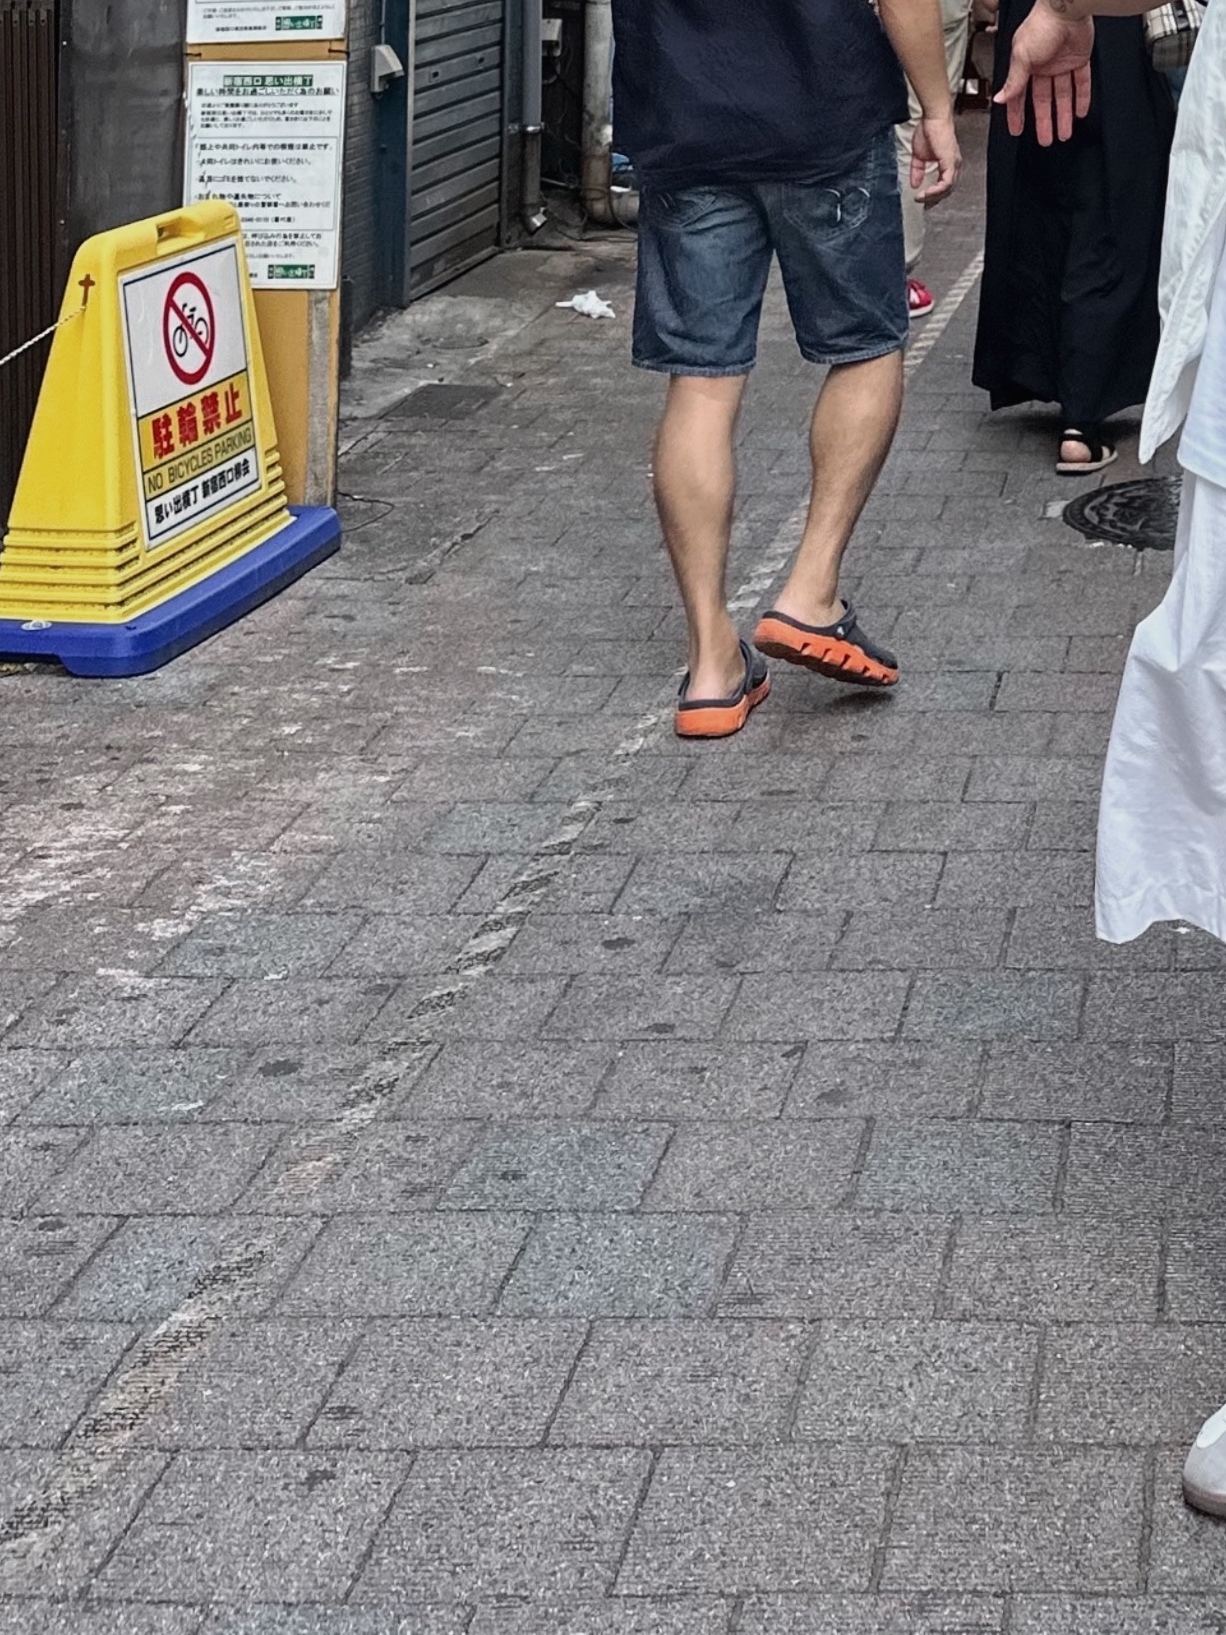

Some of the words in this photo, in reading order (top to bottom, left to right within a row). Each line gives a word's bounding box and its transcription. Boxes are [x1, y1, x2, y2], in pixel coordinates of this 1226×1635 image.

[151, 381, 243, 461] 駐輪禁止
[147, 472, 164, 495] NO
[167, 449, 214, 484] BICYCLES
[214, 426, 253, 461] PARKING
[154, 484, 200, 525] 思い出横丁
